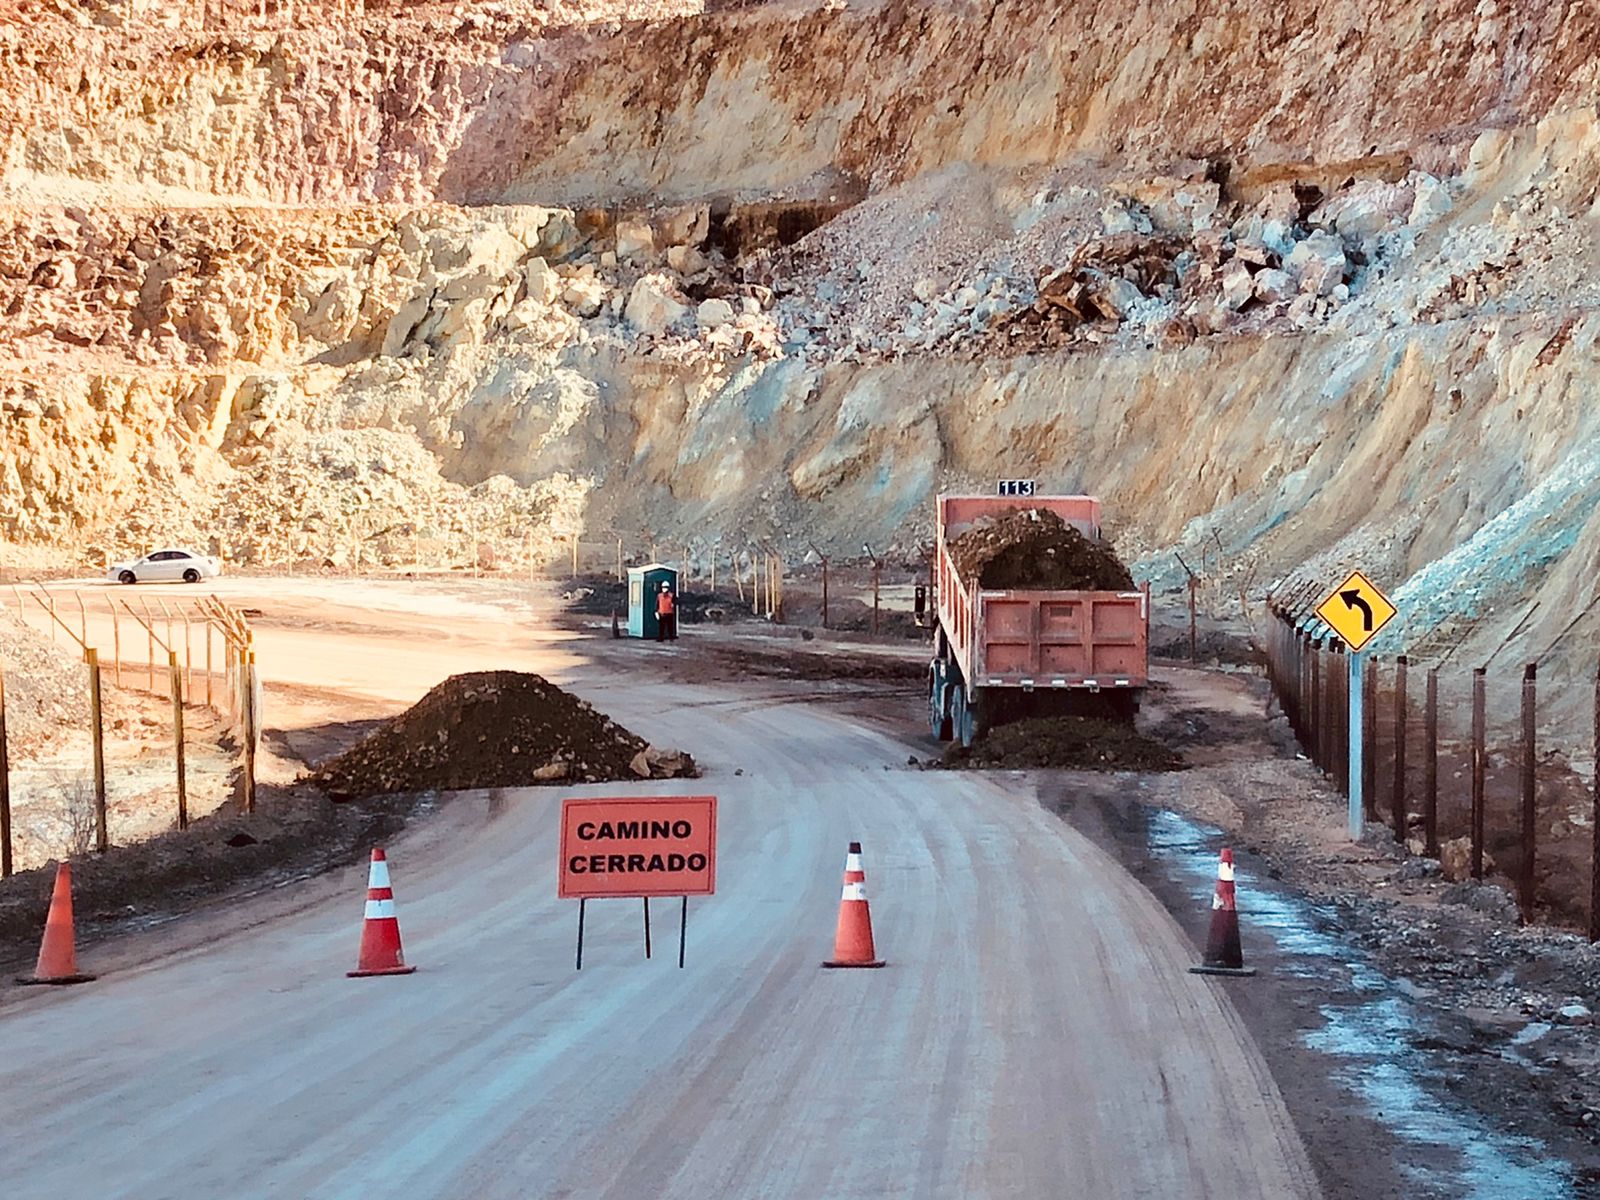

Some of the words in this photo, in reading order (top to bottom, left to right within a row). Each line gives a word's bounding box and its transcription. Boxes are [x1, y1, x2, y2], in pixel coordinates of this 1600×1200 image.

[1001, 480, 1033, 496] 113
[576, 820, 693, 841] CAMINO
[568, 853, 707, 874] CERRADO
